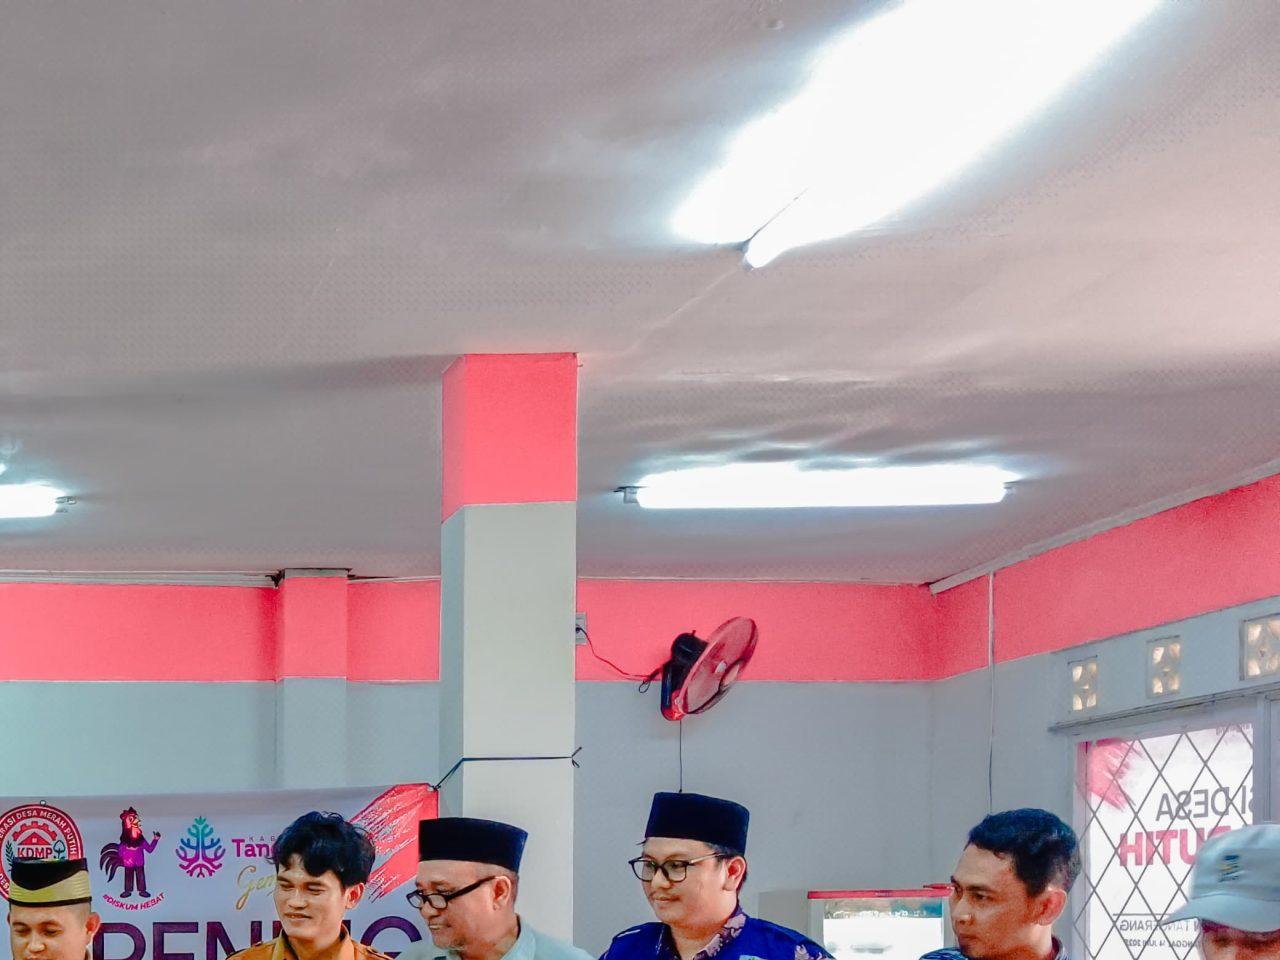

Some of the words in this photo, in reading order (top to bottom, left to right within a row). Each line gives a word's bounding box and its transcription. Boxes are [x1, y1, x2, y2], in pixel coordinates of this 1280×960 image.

[15, 809, 39, 820] DESA
[39, 810, 67, 830] MERAH
[63, 828, 78, 855] PUTIH
[17, 847, 53, 859] KDMP
[231, 838, 275, 858] Tan
